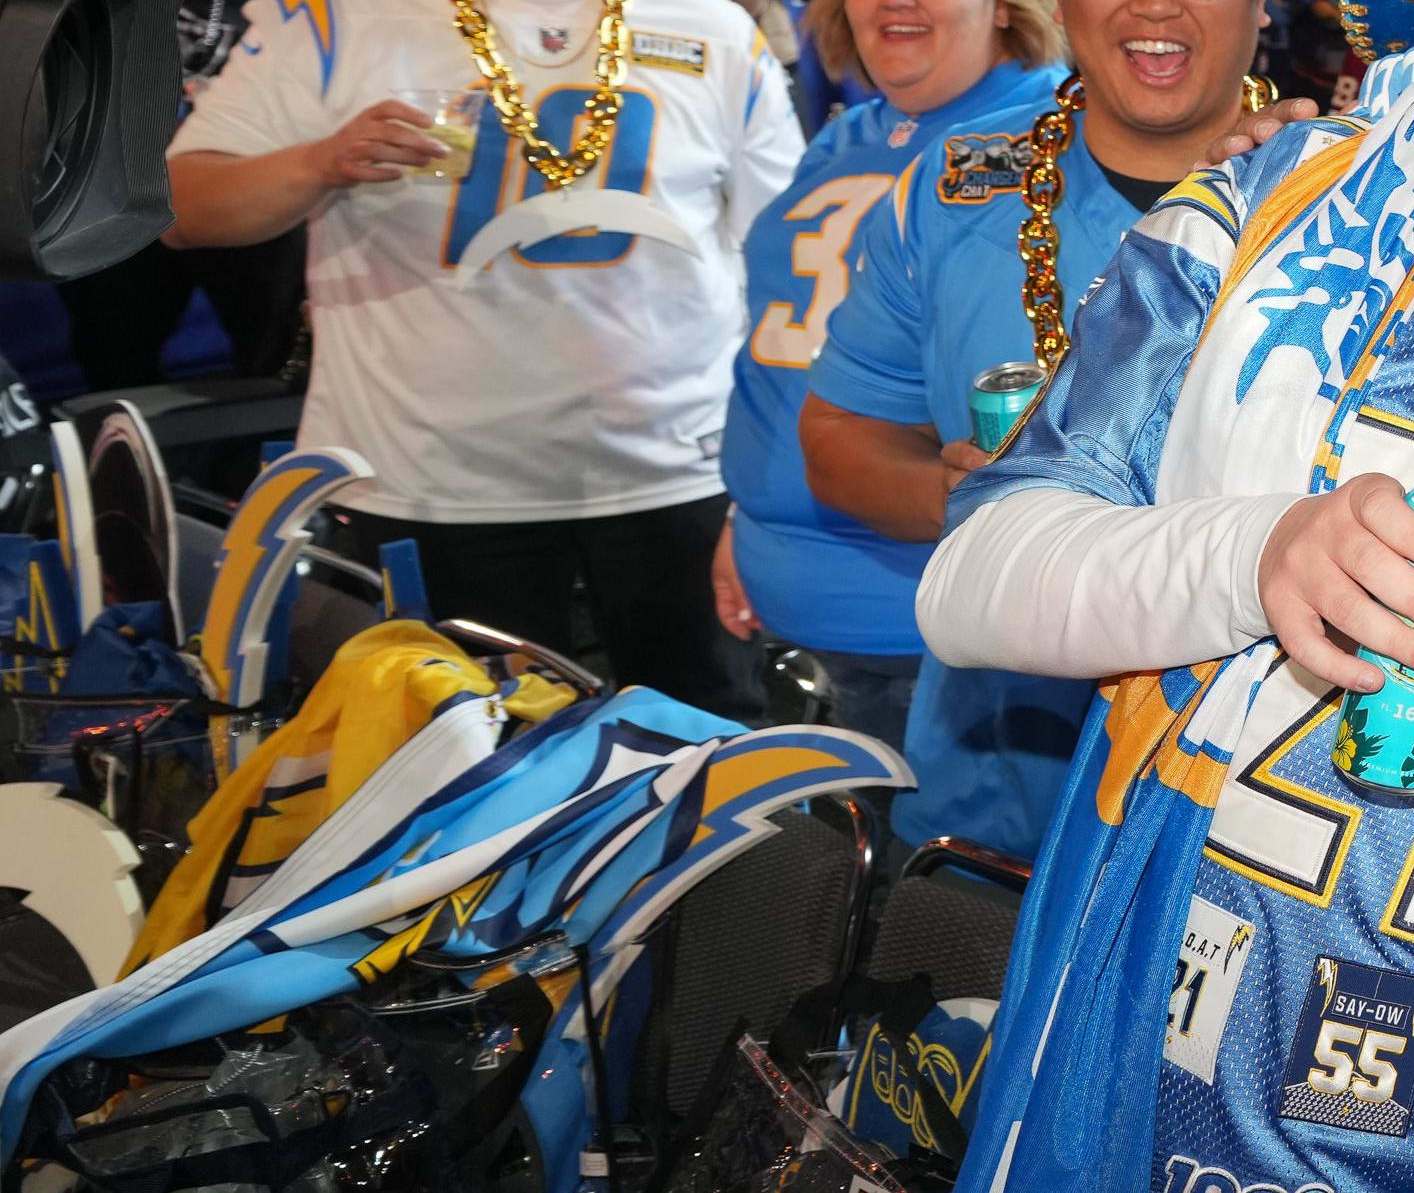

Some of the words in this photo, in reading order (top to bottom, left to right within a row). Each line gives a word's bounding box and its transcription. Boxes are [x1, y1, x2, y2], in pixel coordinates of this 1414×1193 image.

[440, 84, 663, 270] 10
[1335, 995, 1405, 1024] SAY-OW
[1307, 1019, 1408, 1105] 55
